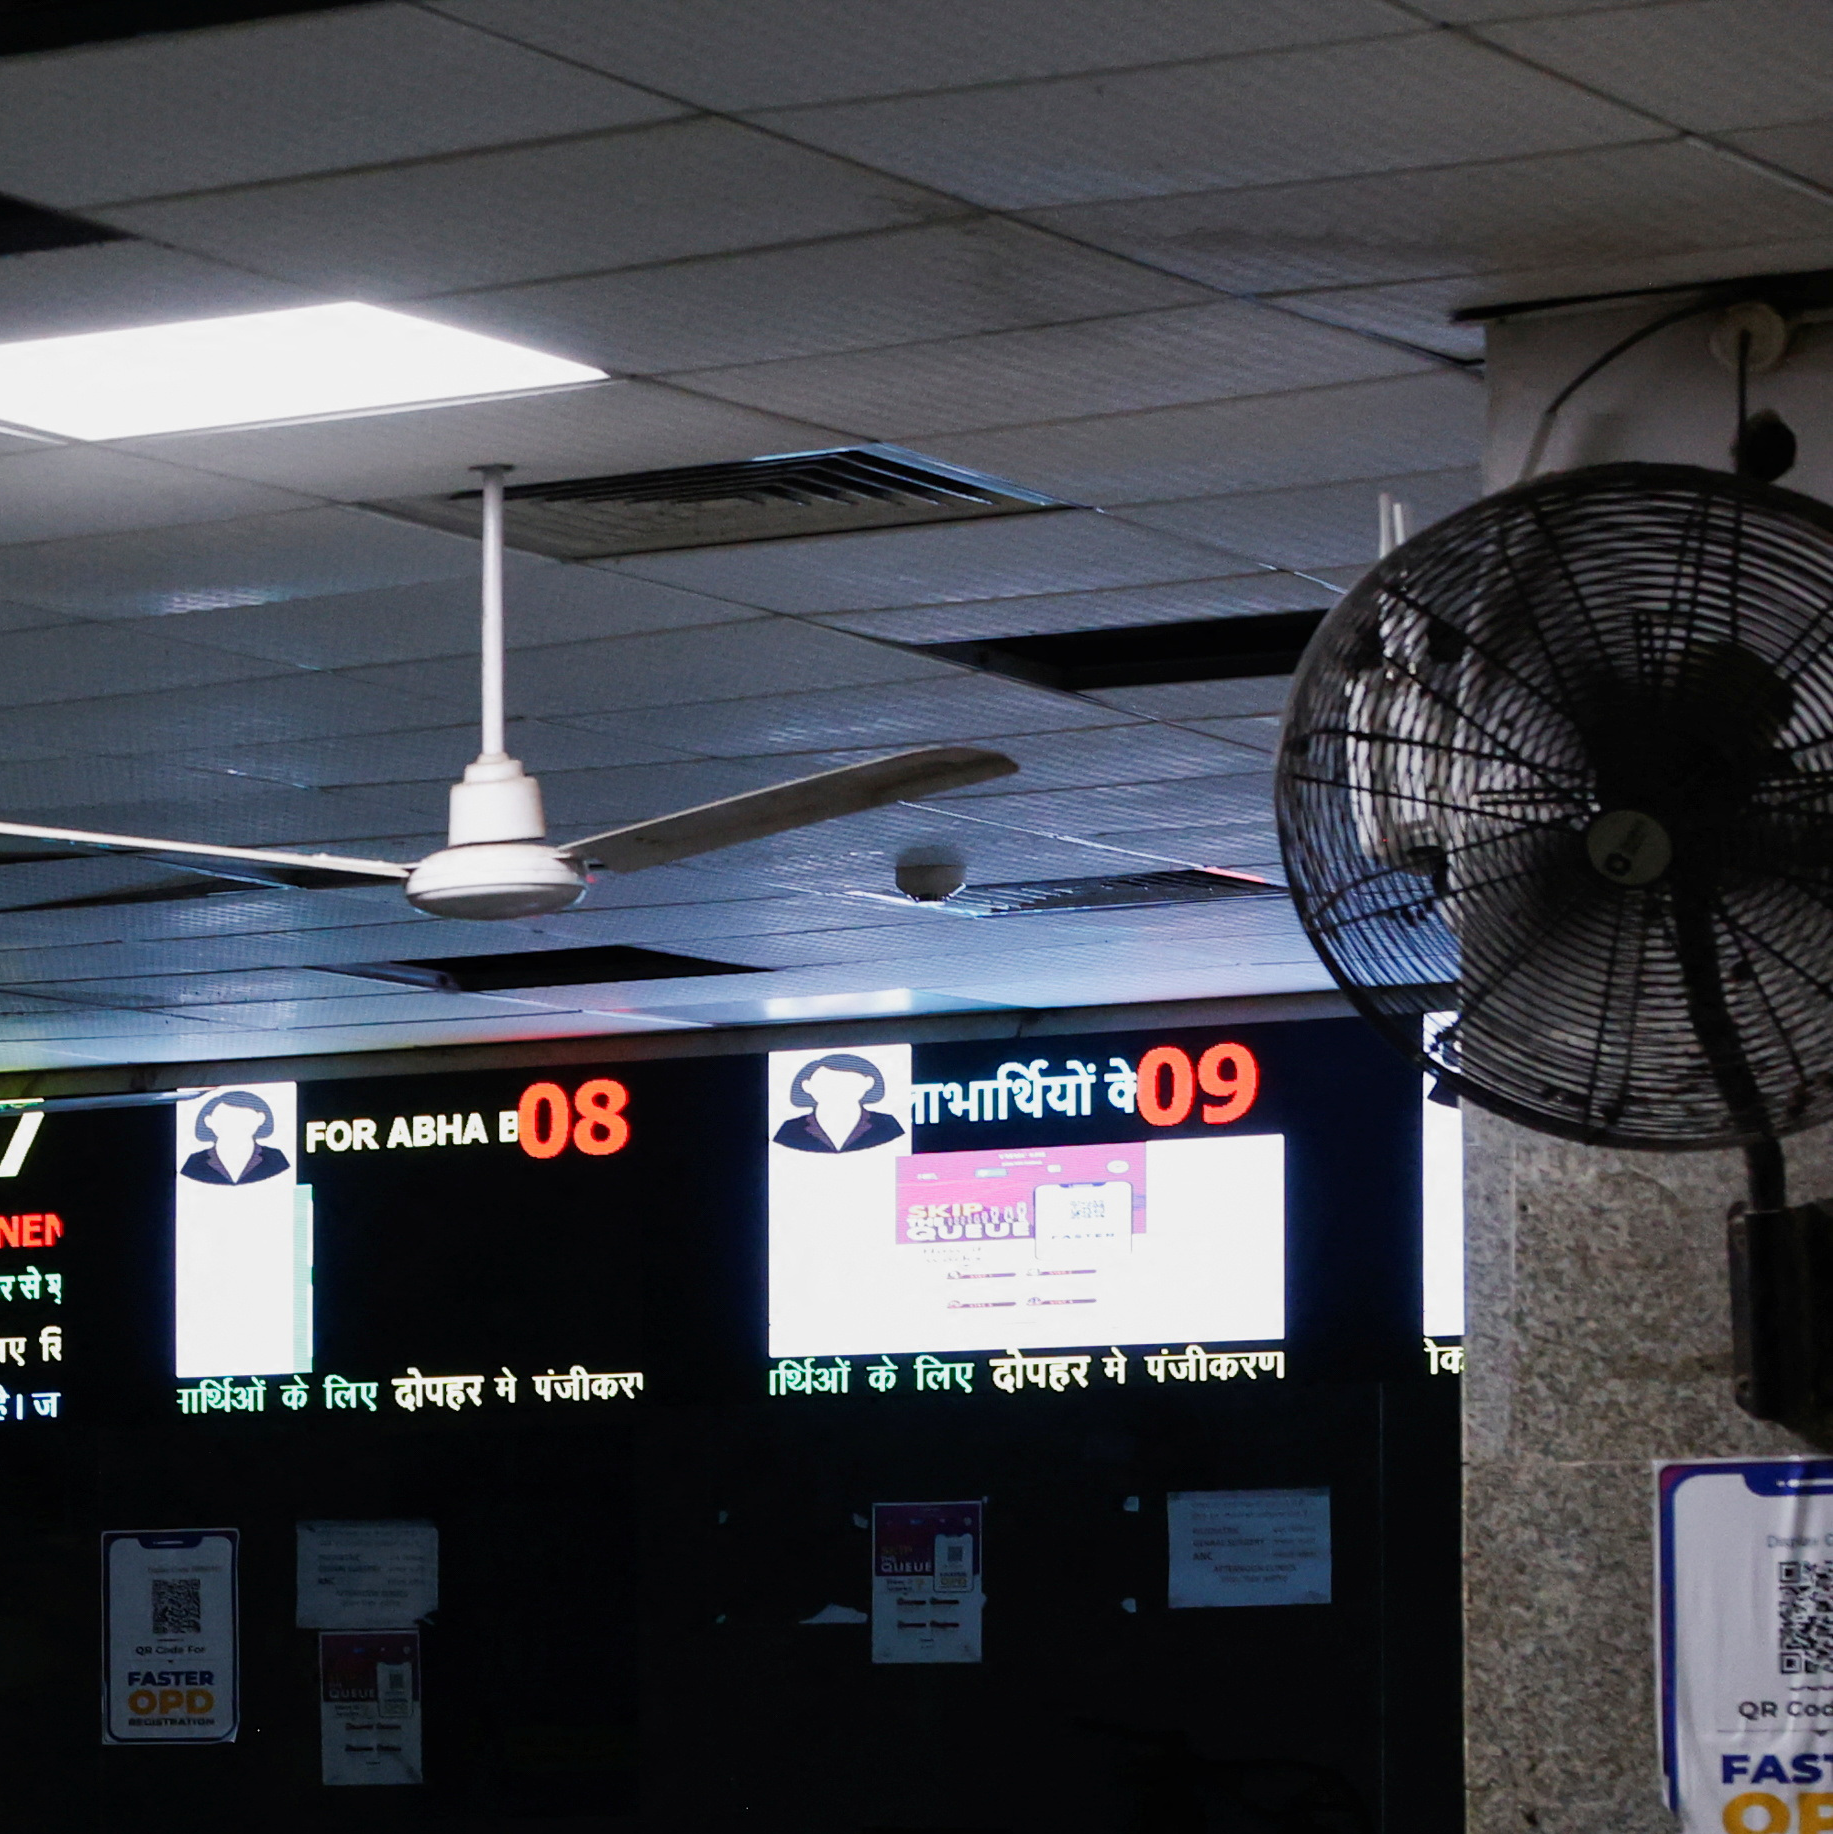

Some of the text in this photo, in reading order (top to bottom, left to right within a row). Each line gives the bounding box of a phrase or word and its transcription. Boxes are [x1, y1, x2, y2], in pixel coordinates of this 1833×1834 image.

[1136, 1042, 1258, 1126] 09
[306, 1113, 488, 1153] FOR ABHA
[518, 1078, 629, 1159] 08
[908, 1202, 984, 1218] SKIP
[906, 1221, 1032, 1242] QUEUE
[18, 1266, 42, 1299] से
[867, 1345, 1284, 1393] के लिए दोपहर पंजीकरण
[280, 1368, 484, 1411] के लिए दोपहर
[128, 1671, 214, 1686] FASTER
[128, 1689, 214, 1715] OPD
[1738, 1701, 1778, 1720] QR
[128, 1717, 215, 1726] REGISTRATION
